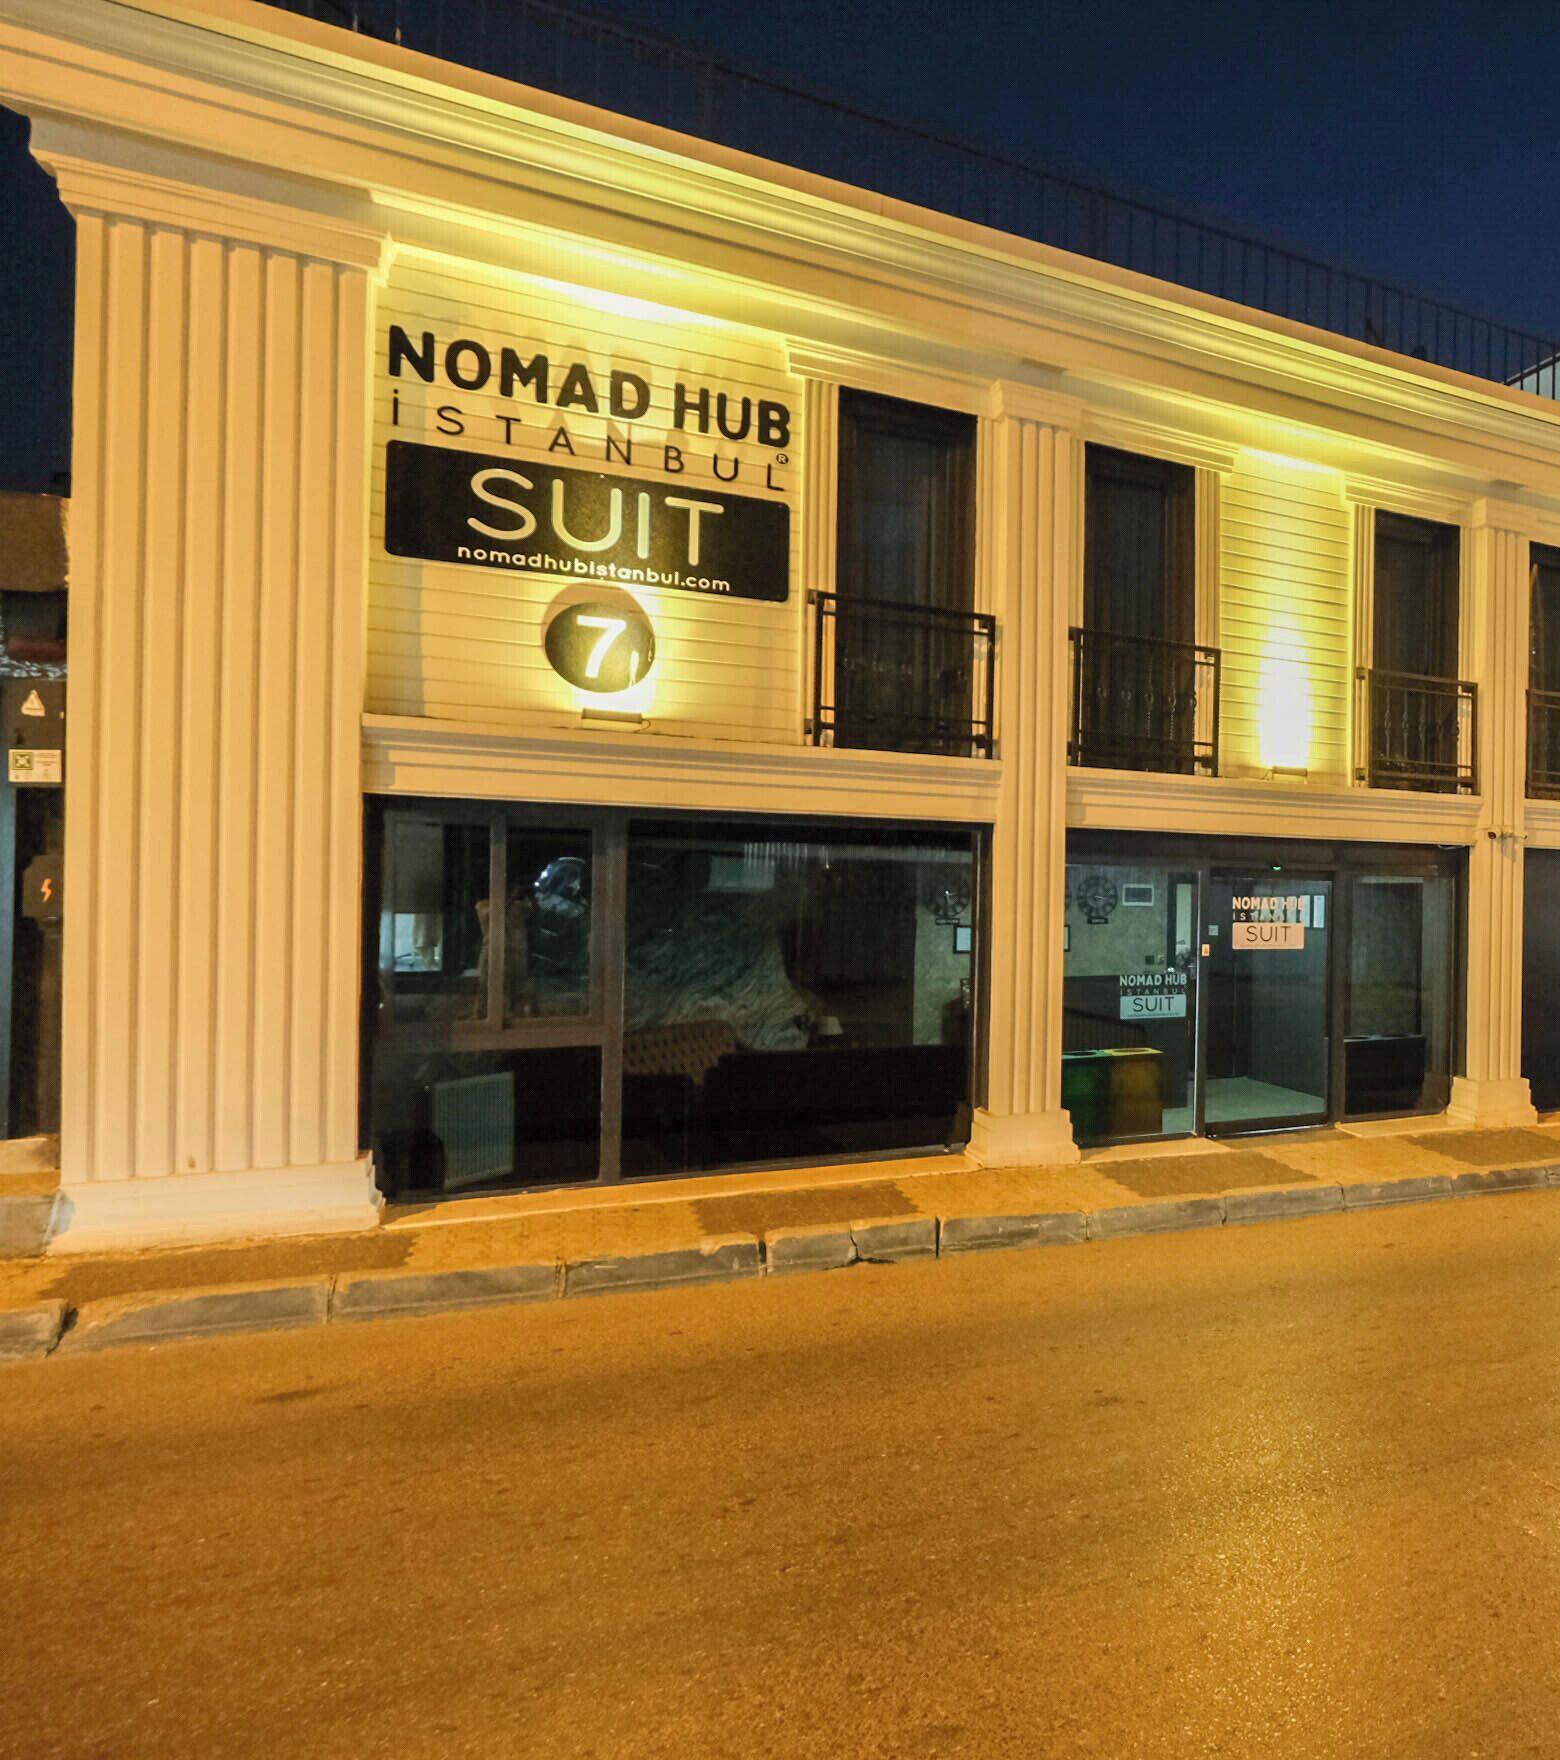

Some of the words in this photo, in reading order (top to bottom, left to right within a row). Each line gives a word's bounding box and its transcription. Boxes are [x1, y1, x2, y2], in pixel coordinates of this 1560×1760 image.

[388, 324, 651, 420] NOMAD
[673, 382, 791, 448] HUB
[467, 468, 725, 567] SUIT
[457, 545, 731, 592] nomadhubistanbul.com
[575, 614, 627, 679] 7
[1232, 896, 1279, 911] NOMAD
[1245, 925, 1292, 943] SUIT
[1119, 974, 1163, 987] NOMAD
[1164, 973, 1188, 986] HUB
[1132, 996, 1175, 1012] SUIT
